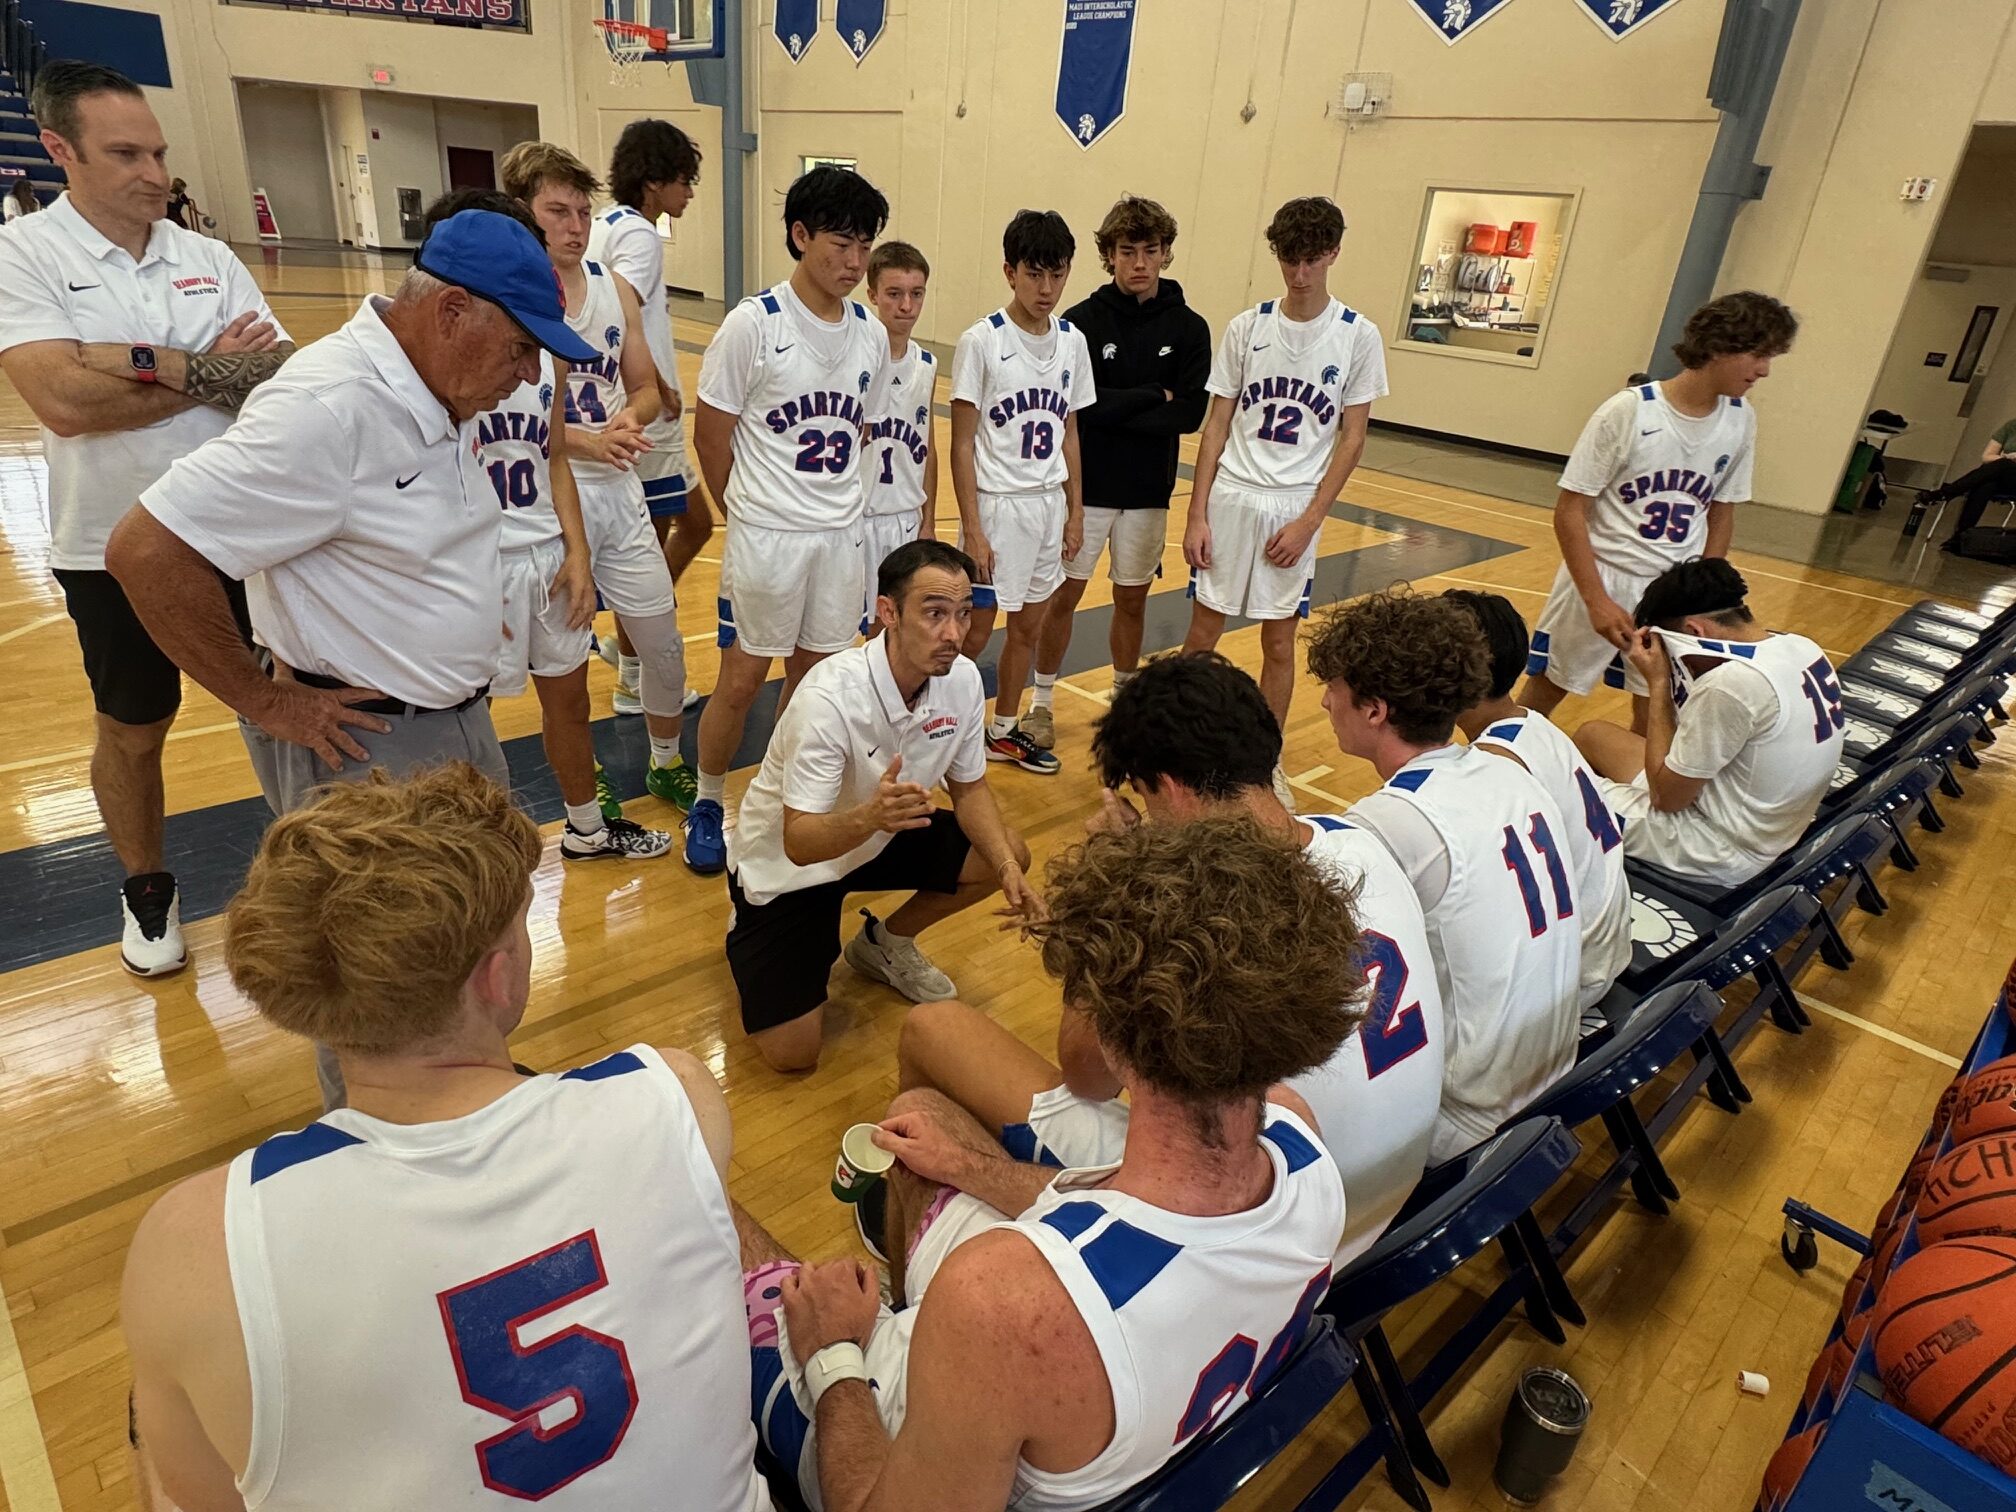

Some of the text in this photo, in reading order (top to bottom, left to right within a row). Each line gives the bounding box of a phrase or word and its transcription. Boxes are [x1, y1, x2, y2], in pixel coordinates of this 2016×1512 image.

[184, 288, 219, 296] ATHLETICS
[766, 391, 864, 438] SPARTAN
[988, 388, 1069, 430] SPARTAN
[1241, 376, 1335, 425] SPARTANS
[1257, 403, 1303, 445] 12
[795, 429, 853, 474] 23
[872, 417, 928, 465] ARTANS
[1020, 420, 1054, 460] 13
[486, 458, 538, 511] 10
[879, 446, 894, 484] 1
[1618, 469, 1714, 511] SPARTAN
[1638, 501, 1696, 543] 35
[1801, 655, 1845, 744] 15
[1574, 766, 1623, 854] 4
[1501, 812, 1574, 939] 11
[1350, 928, 1429, 1081] 2
[435, 1228, 640, 1502] 5
